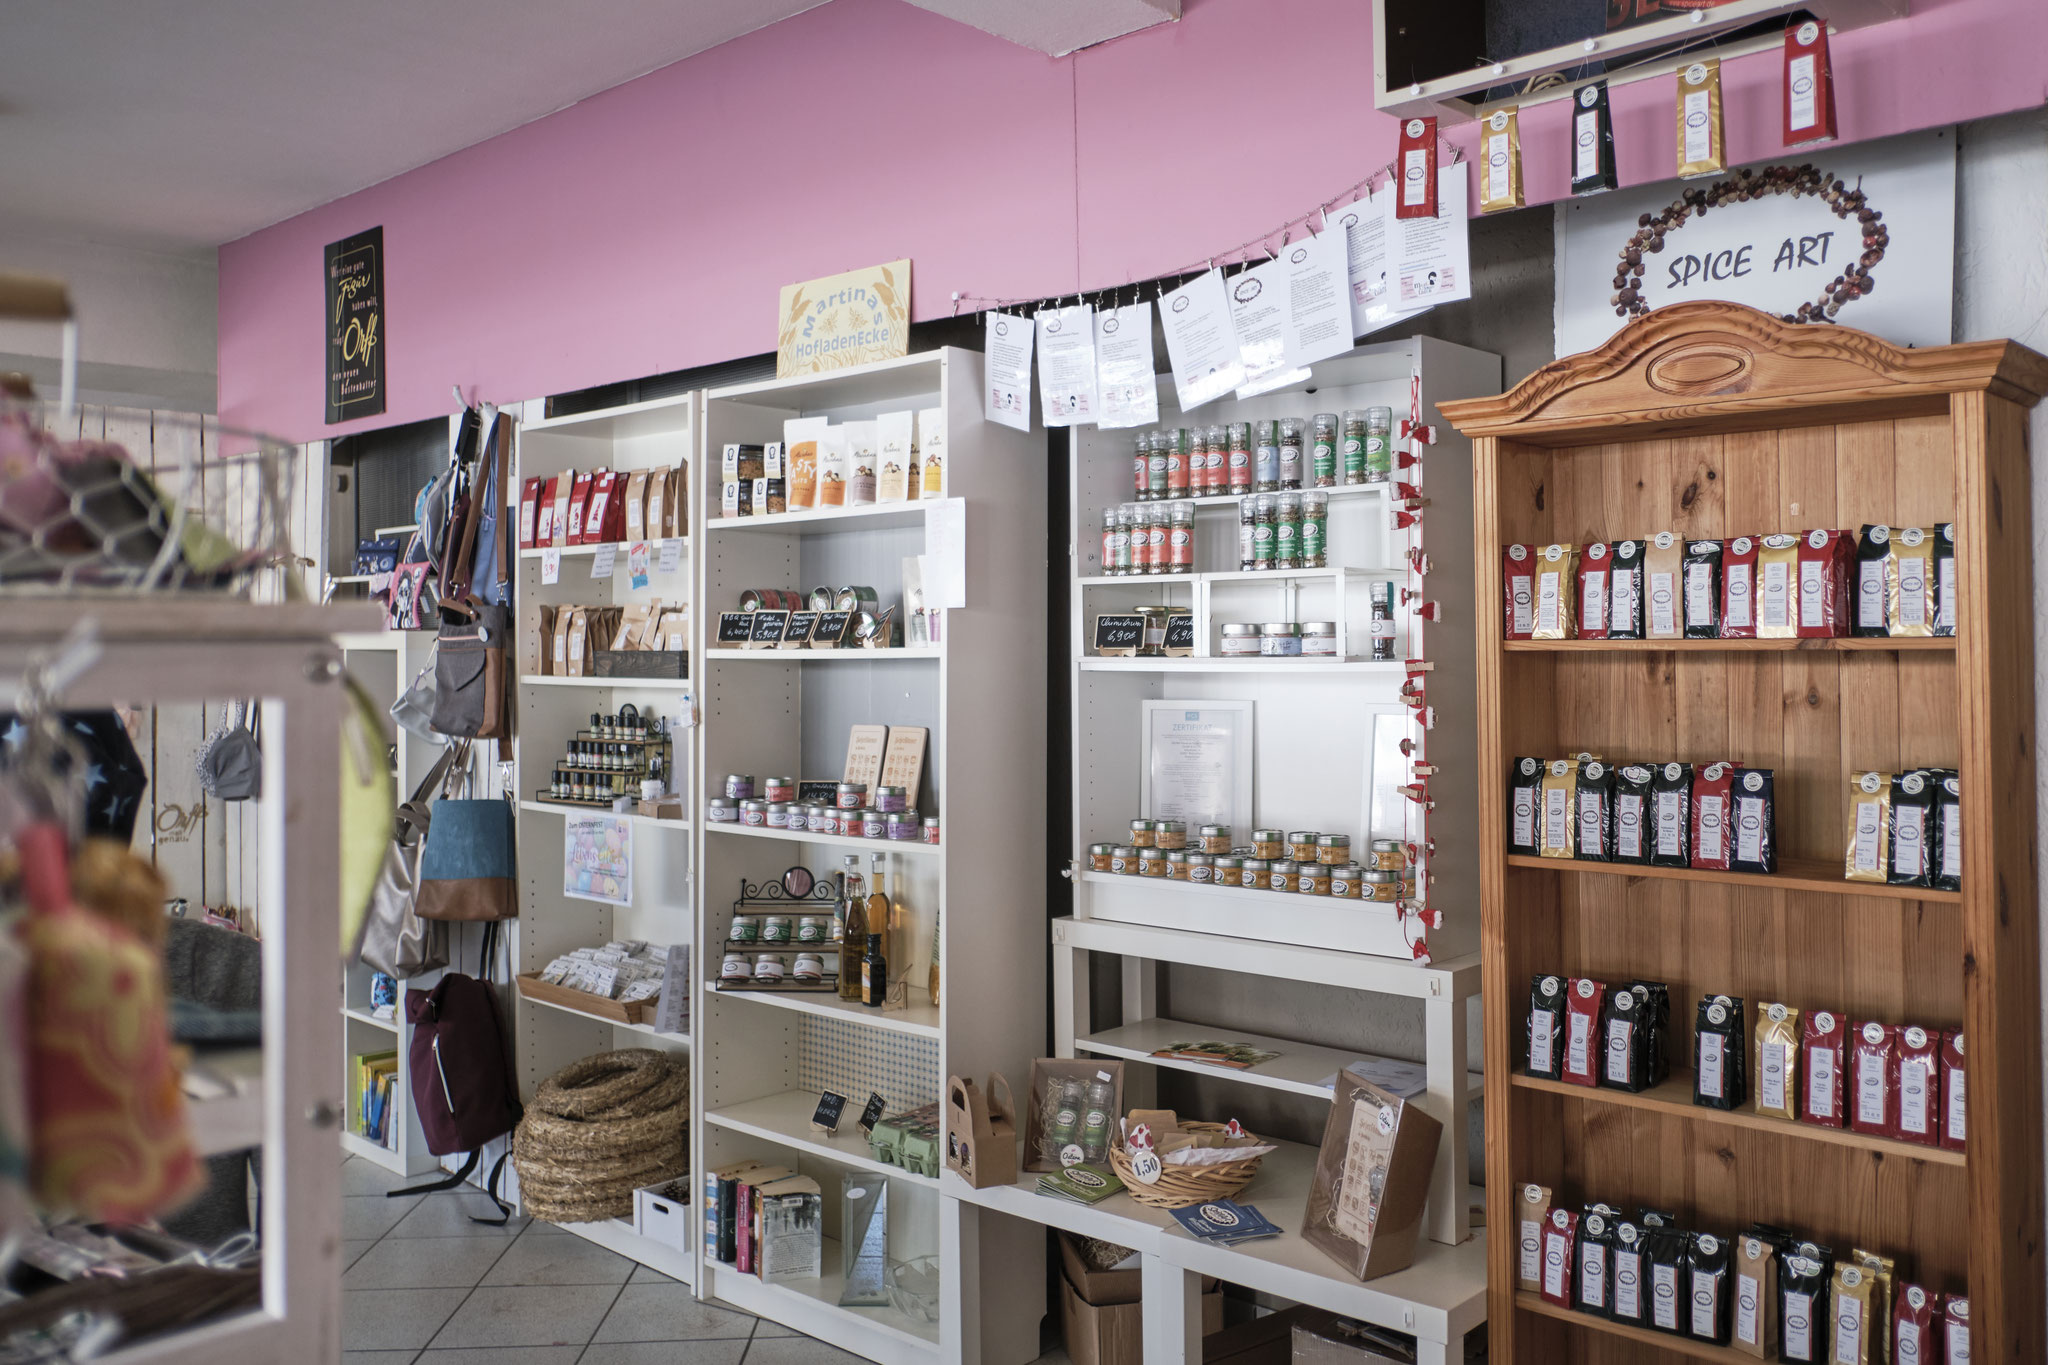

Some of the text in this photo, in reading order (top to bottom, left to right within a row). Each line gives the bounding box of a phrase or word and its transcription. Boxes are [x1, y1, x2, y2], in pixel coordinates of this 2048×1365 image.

[353, 261, 365, 275] gute
[1667, 231, 1834, 289] SPICE ART
[352, 301, 366, 312] haben
[802, 287, 883, 339] Martinas
[343, 312, 378, 368] Orff
[796, 327, 890, 359] HofladenEcke
[332, 371, 342, 382] den
[1172, 723, 1213, 731] ZERTIFIKAT
[157, 802, 209, 836] Orff
[1133, 1157, 1158, 1178] 1,50
